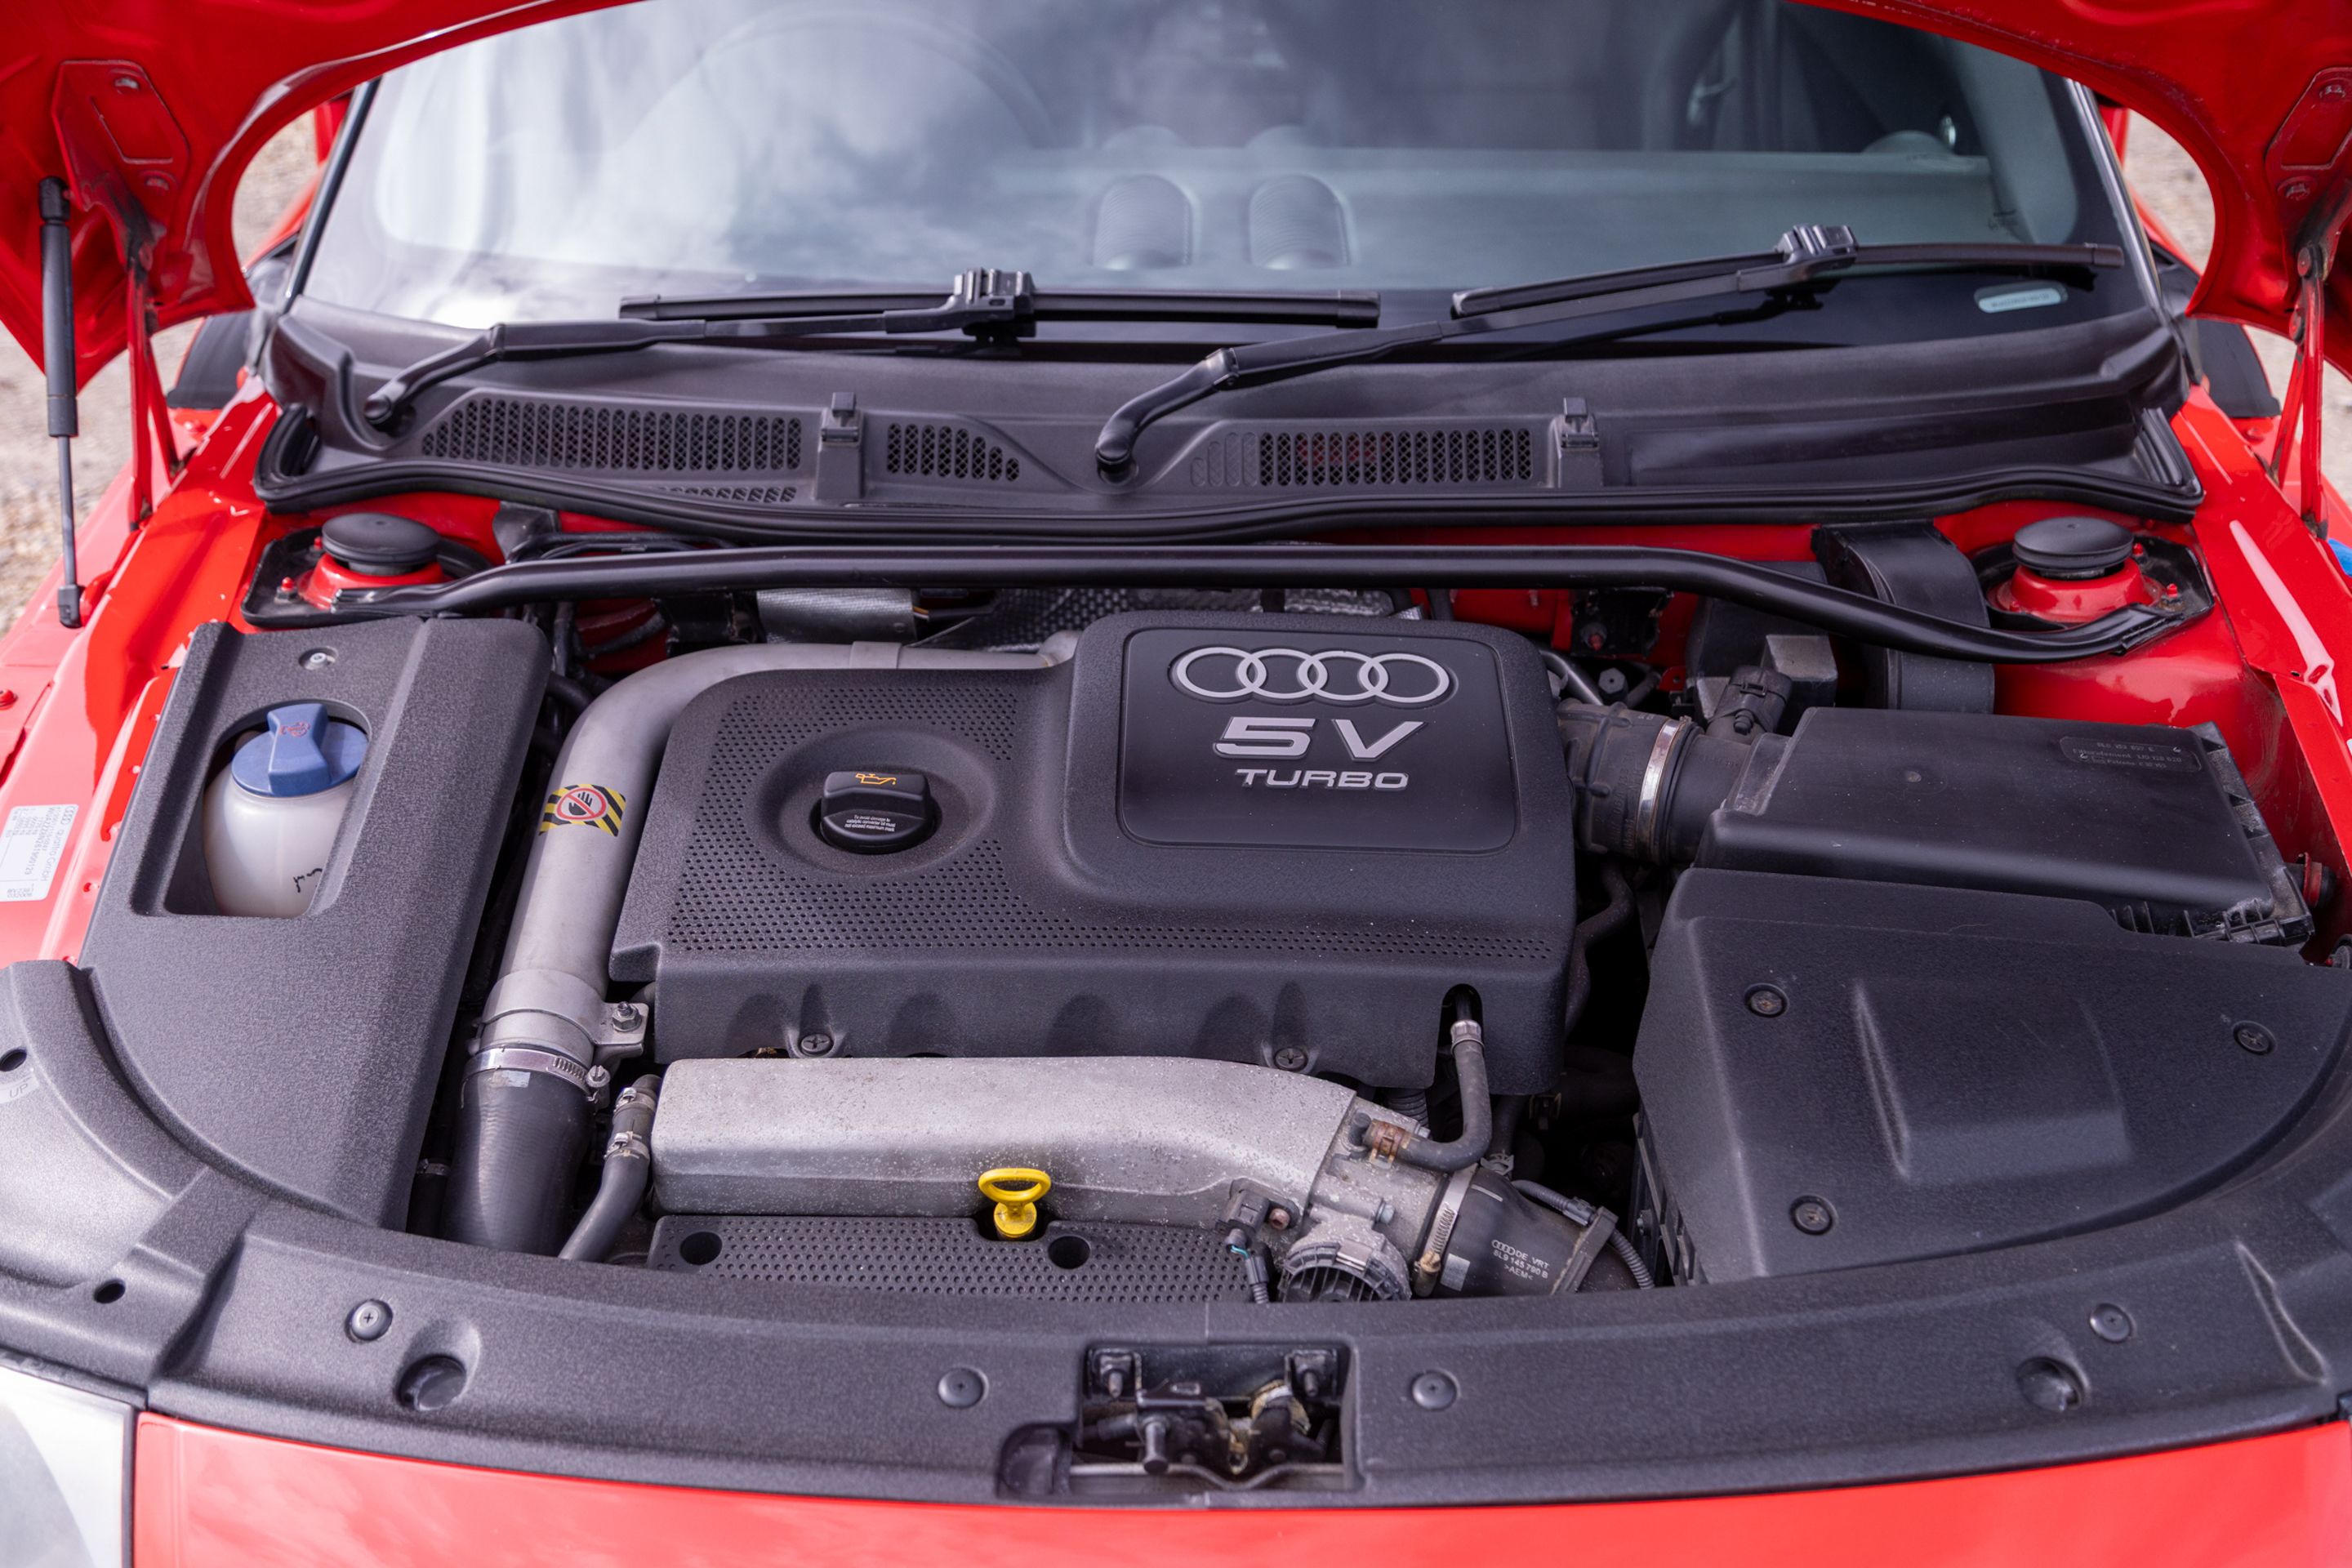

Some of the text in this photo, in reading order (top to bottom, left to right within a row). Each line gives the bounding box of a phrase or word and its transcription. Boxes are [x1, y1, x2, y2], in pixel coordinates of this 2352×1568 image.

[1236, 768, 1409, 790] TURBO
[9, 1083, 28, 1098] UP
[1541, 1270, 1548, 1279] B
